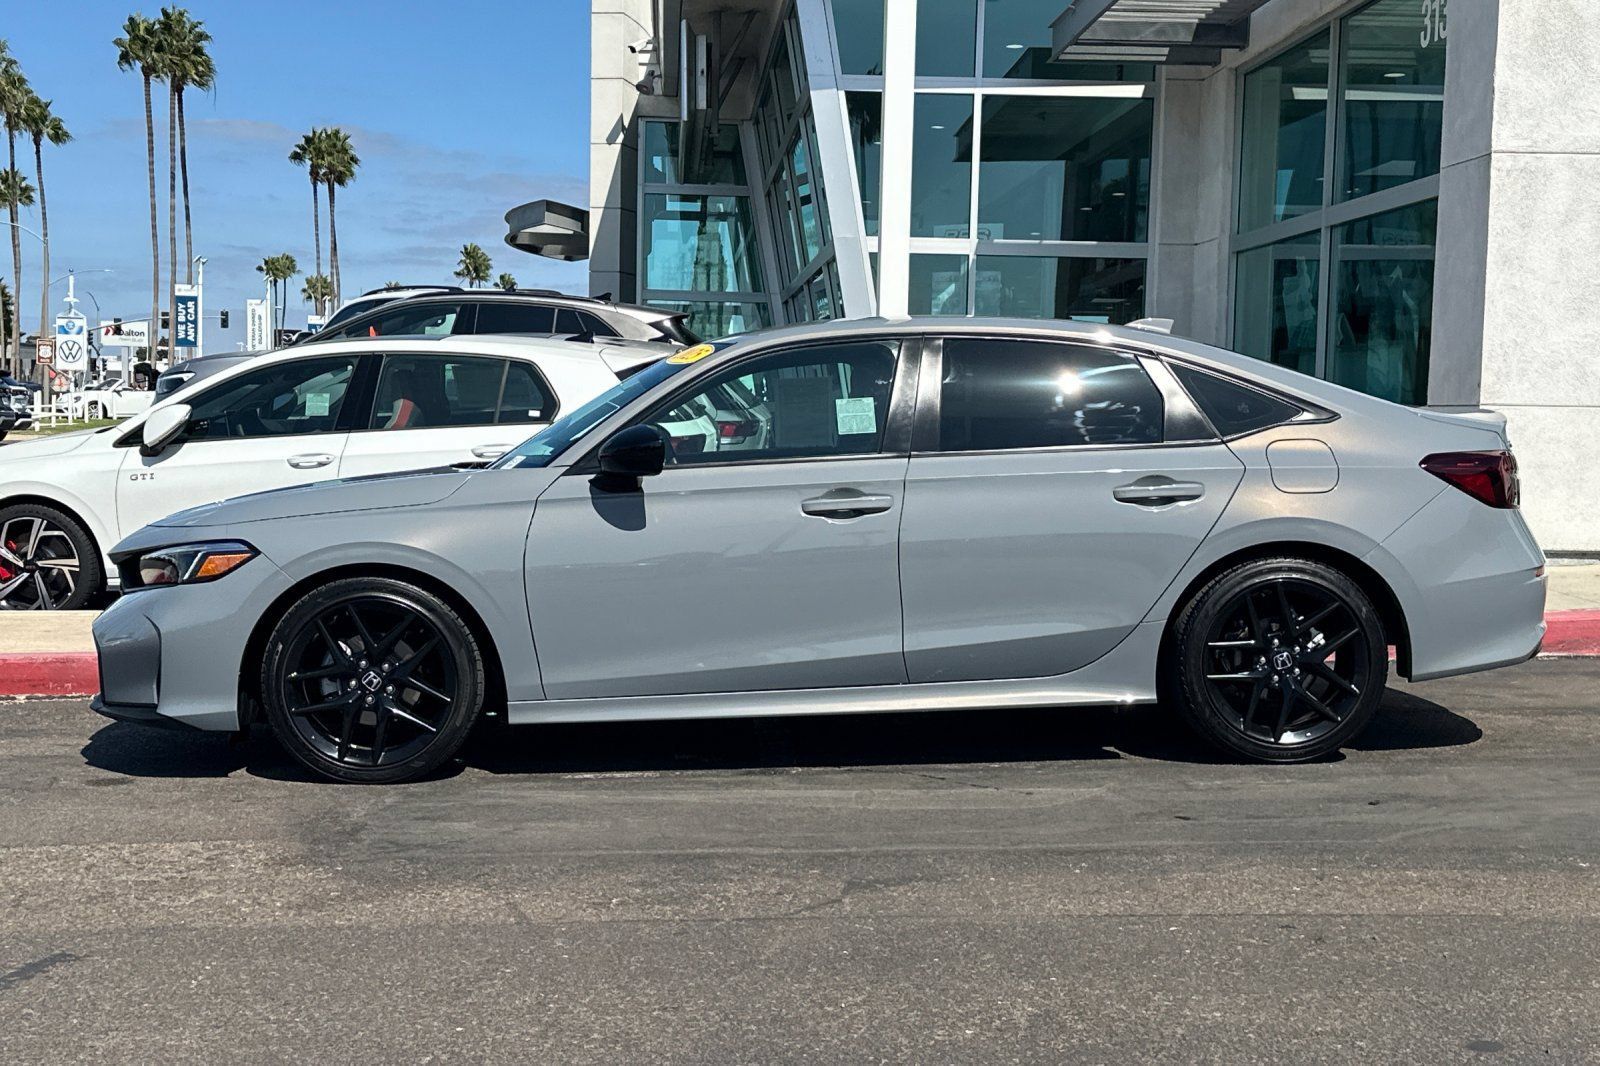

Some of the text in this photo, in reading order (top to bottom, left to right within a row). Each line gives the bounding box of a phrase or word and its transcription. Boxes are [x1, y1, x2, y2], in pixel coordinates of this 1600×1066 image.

[177, 302, 186, 322] BUY
[187, 301, 195, 341] ANY CAR
[177, 323, 186, 339] WE
[130, 472, 154, 481] GTI
